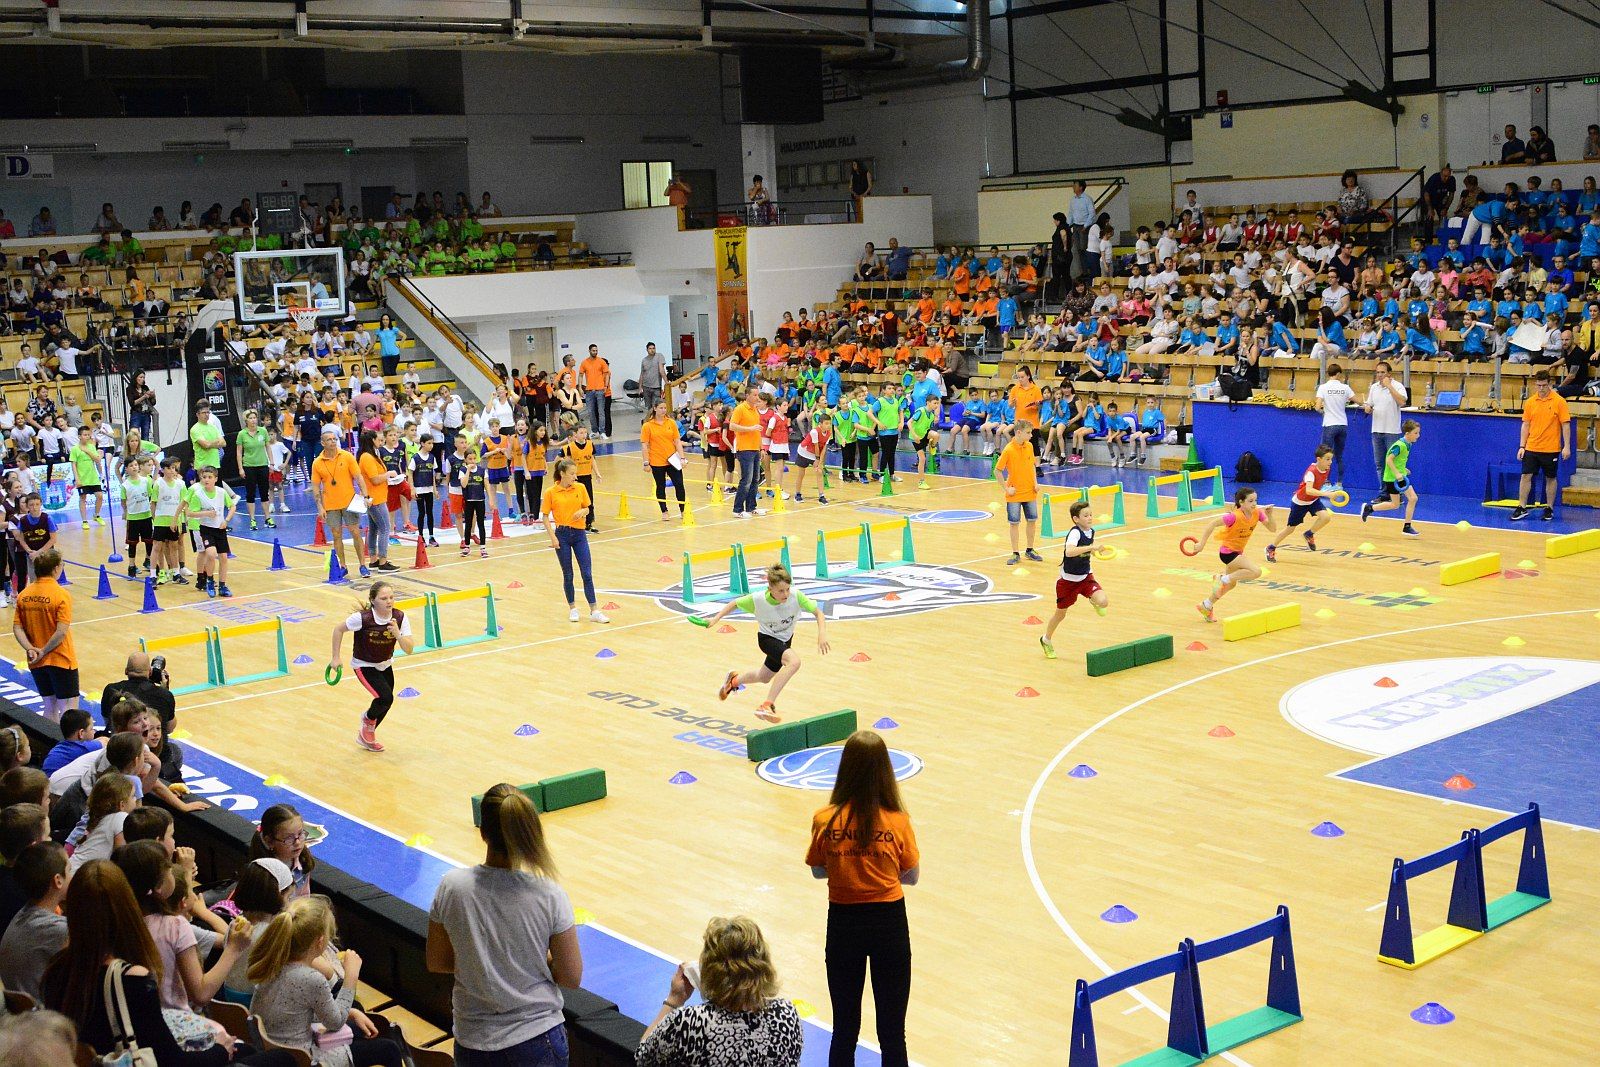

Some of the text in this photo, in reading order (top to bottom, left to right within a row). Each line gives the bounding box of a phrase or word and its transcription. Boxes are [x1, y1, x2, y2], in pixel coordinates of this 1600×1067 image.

[7, 155, 30, 177] D
[208, 395, 225, 405] FIBA
[587, 690, 749, 739] ROPE CUP
